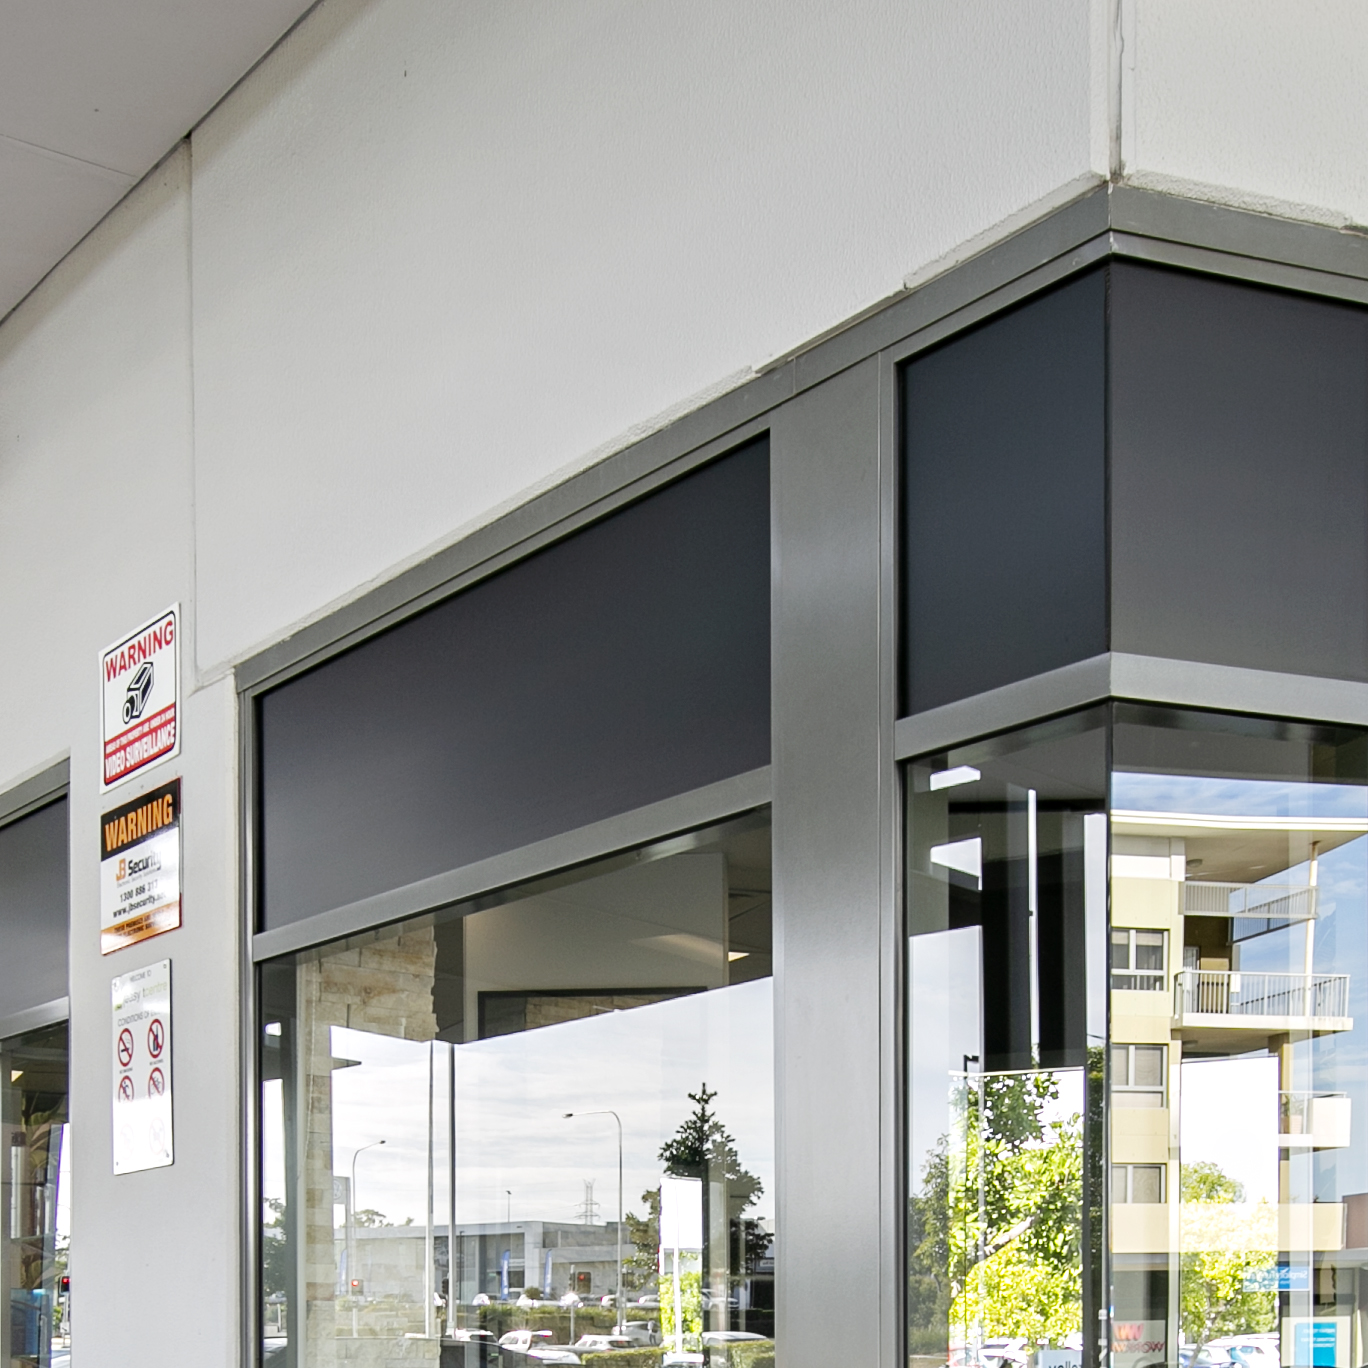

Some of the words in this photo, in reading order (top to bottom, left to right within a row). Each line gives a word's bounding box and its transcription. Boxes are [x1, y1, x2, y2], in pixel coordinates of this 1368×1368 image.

[105, 620, 174, 682] WARNING
[105, 754, 126, 779] VIDEO
[126, 720, 175, 767] SURVEILLANCE
[104, 794, 173, 852] WARNING
[128, 850, 162, 877] Security
[120, 889, 134, 903] 1300
